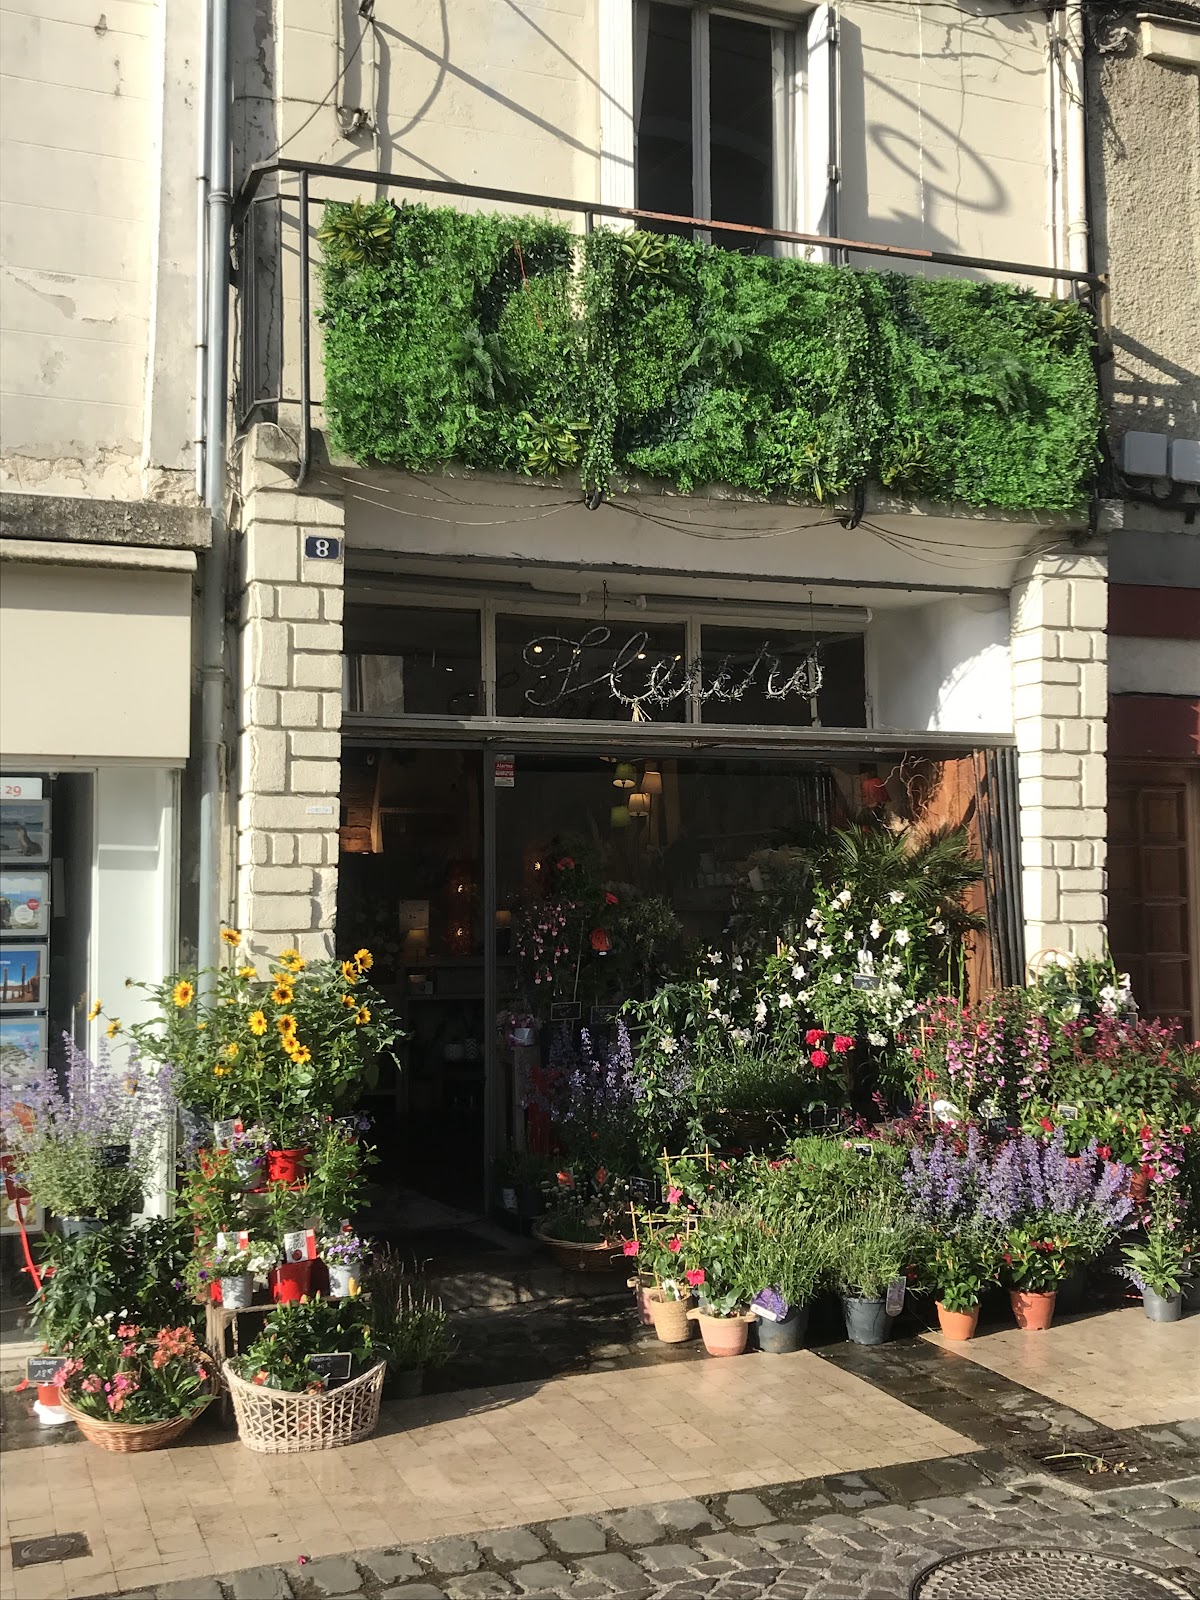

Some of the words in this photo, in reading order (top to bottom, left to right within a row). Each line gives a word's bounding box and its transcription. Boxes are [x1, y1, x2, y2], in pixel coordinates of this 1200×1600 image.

[315, 539, 330, 558] 8
[522, 625, 825, 707] Fleurs
[5, 785, 22, 798] 29
